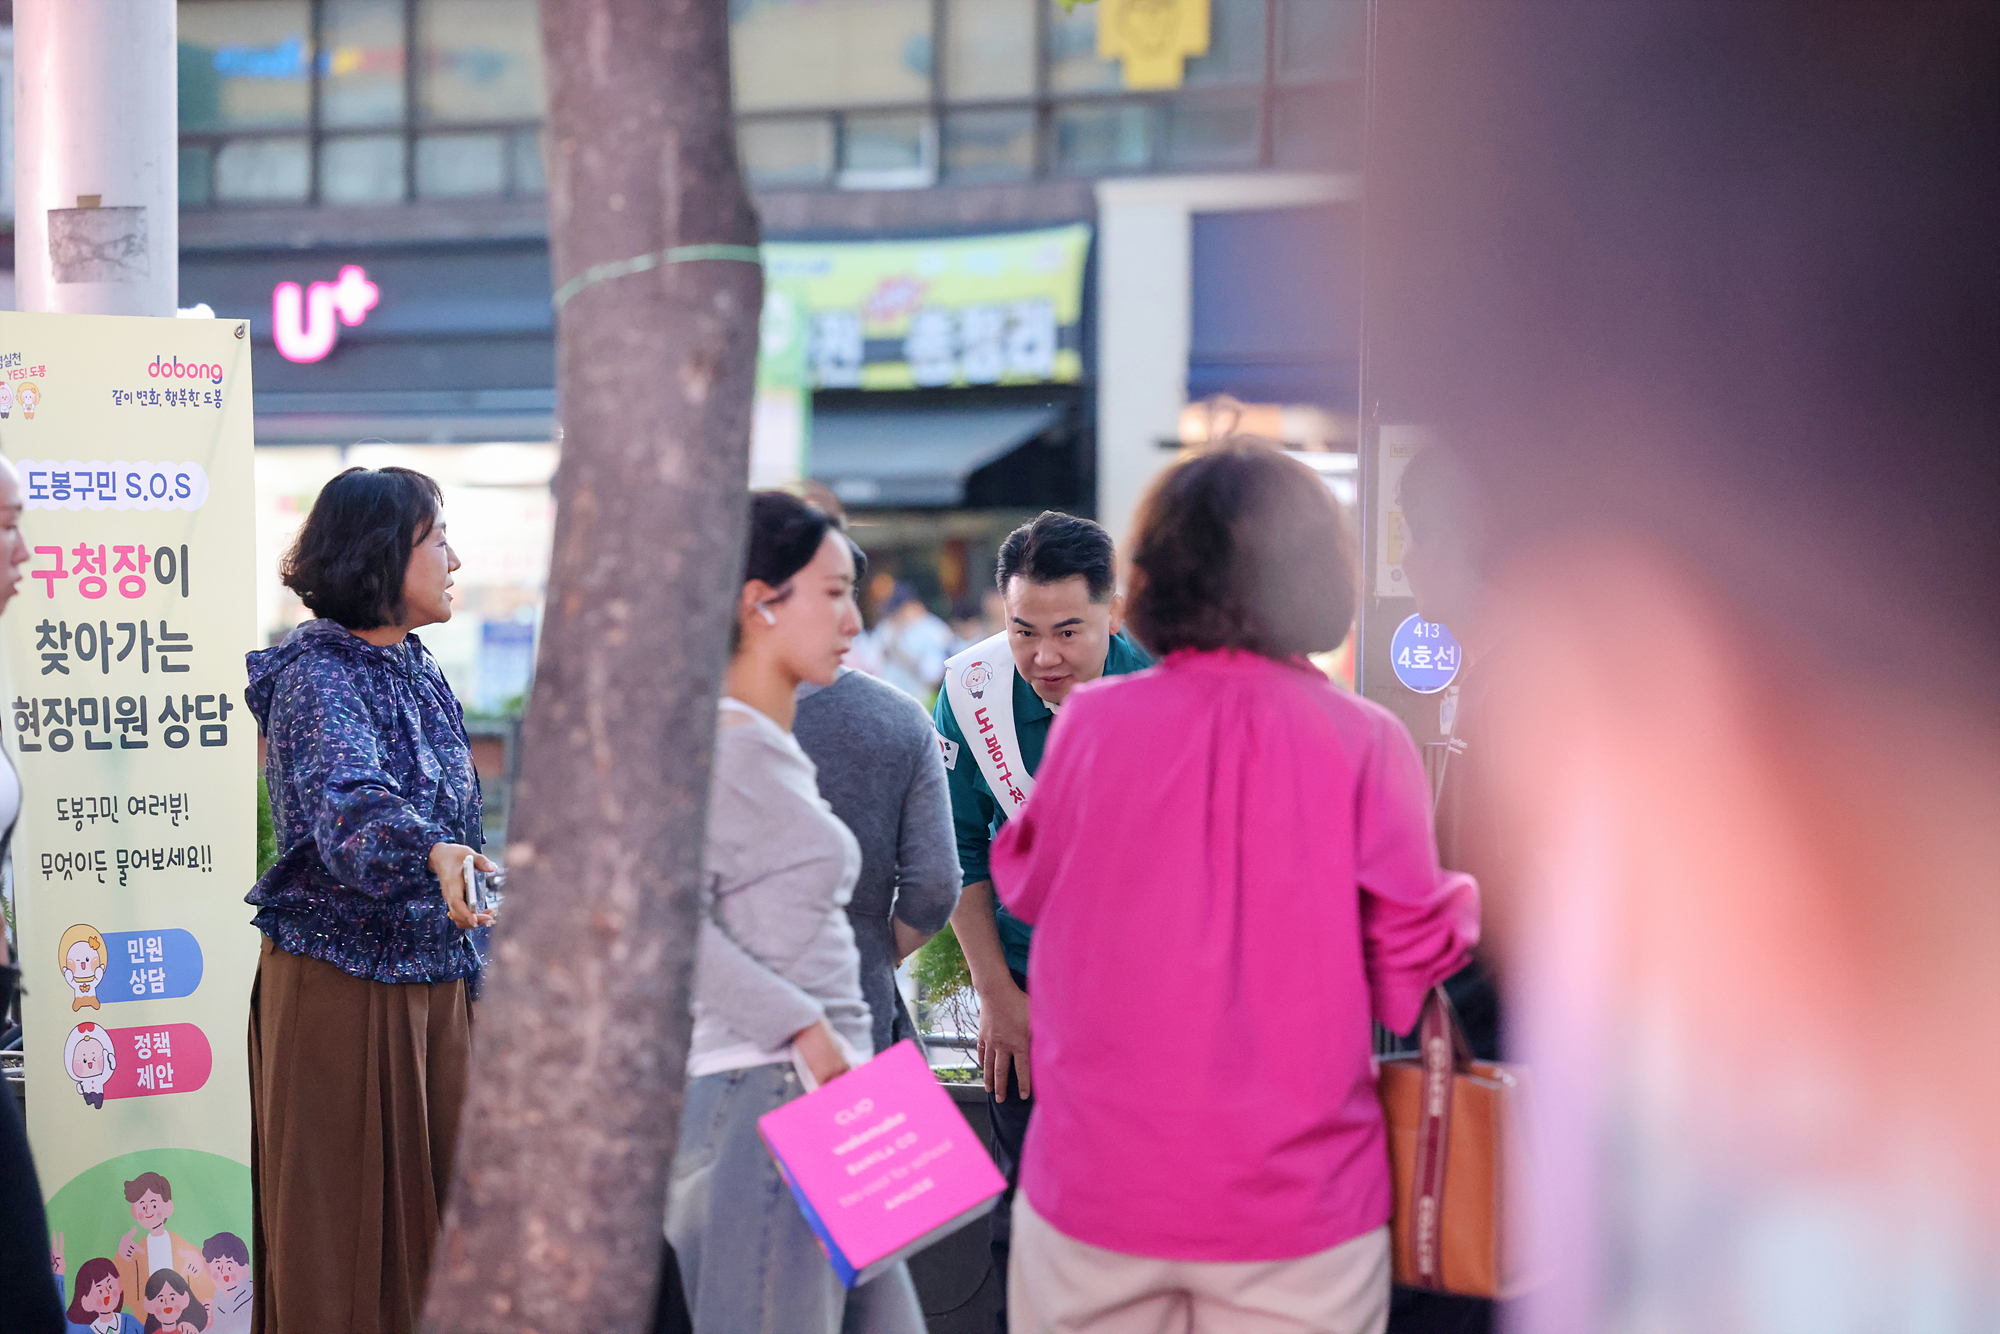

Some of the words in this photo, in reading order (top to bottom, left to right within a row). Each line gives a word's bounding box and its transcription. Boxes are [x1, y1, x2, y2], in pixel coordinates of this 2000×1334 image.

[273, 265, 378, 363] U+
[7, 368, 27, 380] YES!
[29, 365, 47, 378] 도봉
[148, 355, 223, 384] dobong
[112, 389, 133, 406] 같이
[136, 388, 162, 407] 변화,
[165, 388, 200, 407] 행복한
[203, 389, 223, 409] 도봉
[29, 471, 117, 501] 도봉구민
[126, 472, 191, 502] S.O.S
[31, 542, 189, 599] 구청장이
[1413, 622, 1440, 638] 413
[35, 619, 193, 675] 찾아가는
[1397, 645, 1455, 671] 4호선
[11, 695, 149, 752] 현장민원
[158, 693, 234, 749] 상담
[57, 795, 119, 831] 도봉구민
[127, 793, 190, 827] 여러분!
[41, 850, 107, 884] 무엇이든
[116, 845, 213, 887] 물어보세요!!
[127, 936, 164, 964] 민원
[129, 967, 166, 995] 상담
[134, 1031, 171, 1060] 정책
[136, 1064, 174, 1090] 제안
